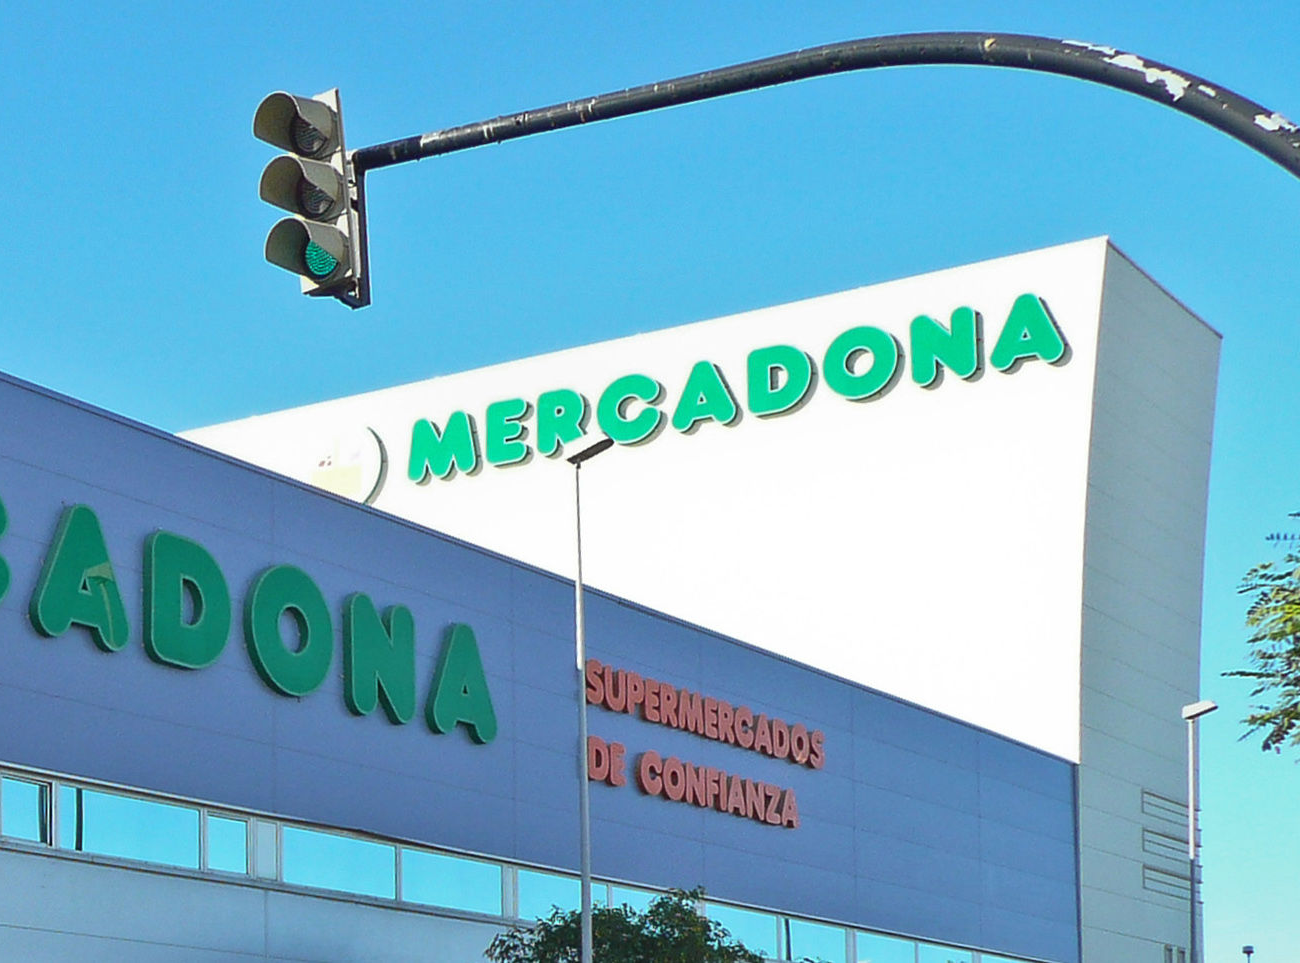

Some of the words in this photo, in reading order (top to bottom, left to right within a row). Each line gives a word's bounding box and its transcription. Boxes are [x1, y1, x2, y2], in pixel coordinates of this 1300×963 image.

[407, 293, 1067, 484] MERCADONA
[585, 658, 825, 769] SUPERMERCADOS
[587, 735, 626, 787] DE
[637, 749, 799, 828] CONFIANZA
